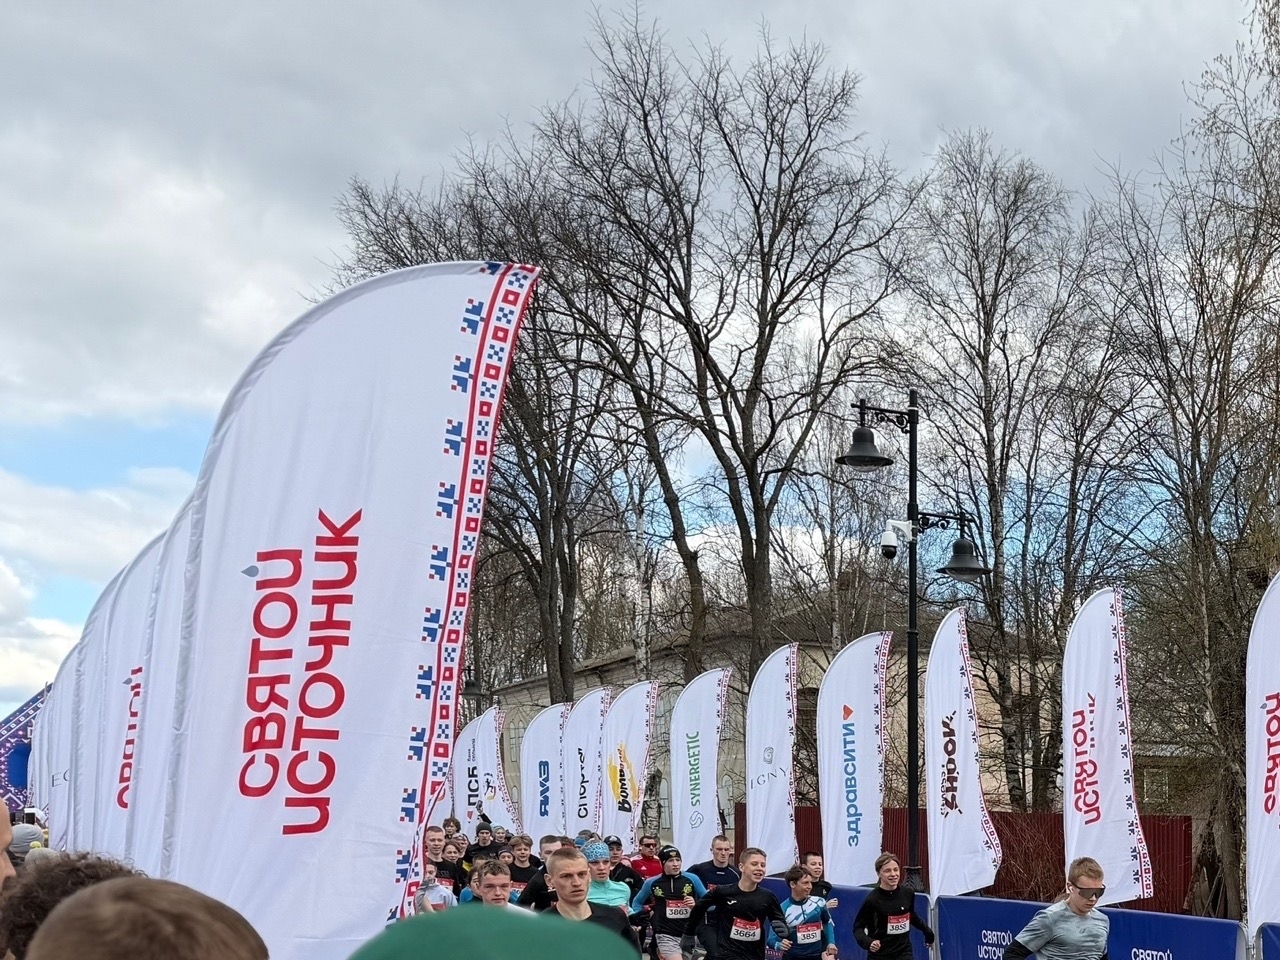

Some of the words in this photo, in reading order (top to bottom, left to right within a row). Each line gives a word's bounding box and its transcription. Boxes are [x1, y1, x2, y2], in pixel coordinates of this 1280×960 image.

[239, 548, 303, 798] СВЯТОЙ
[282, 507, 364, 836] ИСТОЧНИК
[686, 731, 700, 807] SYNERGETIC
[733, 928, 756, 938] 3664
[977, 944, 1005, 960] ИСТОЧ
